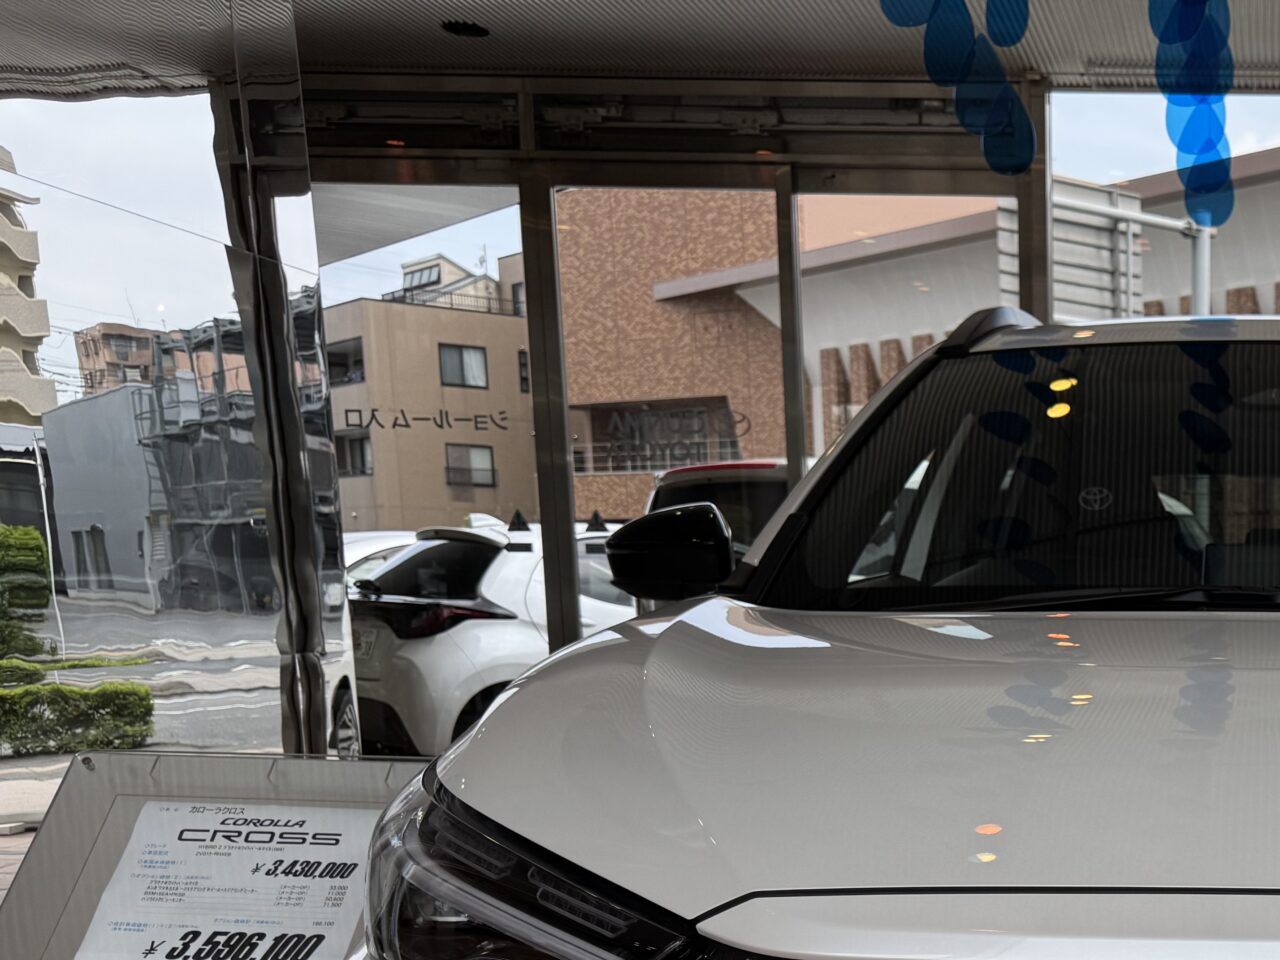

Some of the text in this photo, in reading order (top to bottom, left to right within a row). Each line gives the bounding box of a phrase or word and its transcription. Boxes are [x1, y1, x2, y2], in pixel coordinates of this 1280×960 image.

[188, 806, 245, 816] カローラクロス
[219, 817, 306, 828] COROLLA
[177, 828, 343, 846] CROSS
